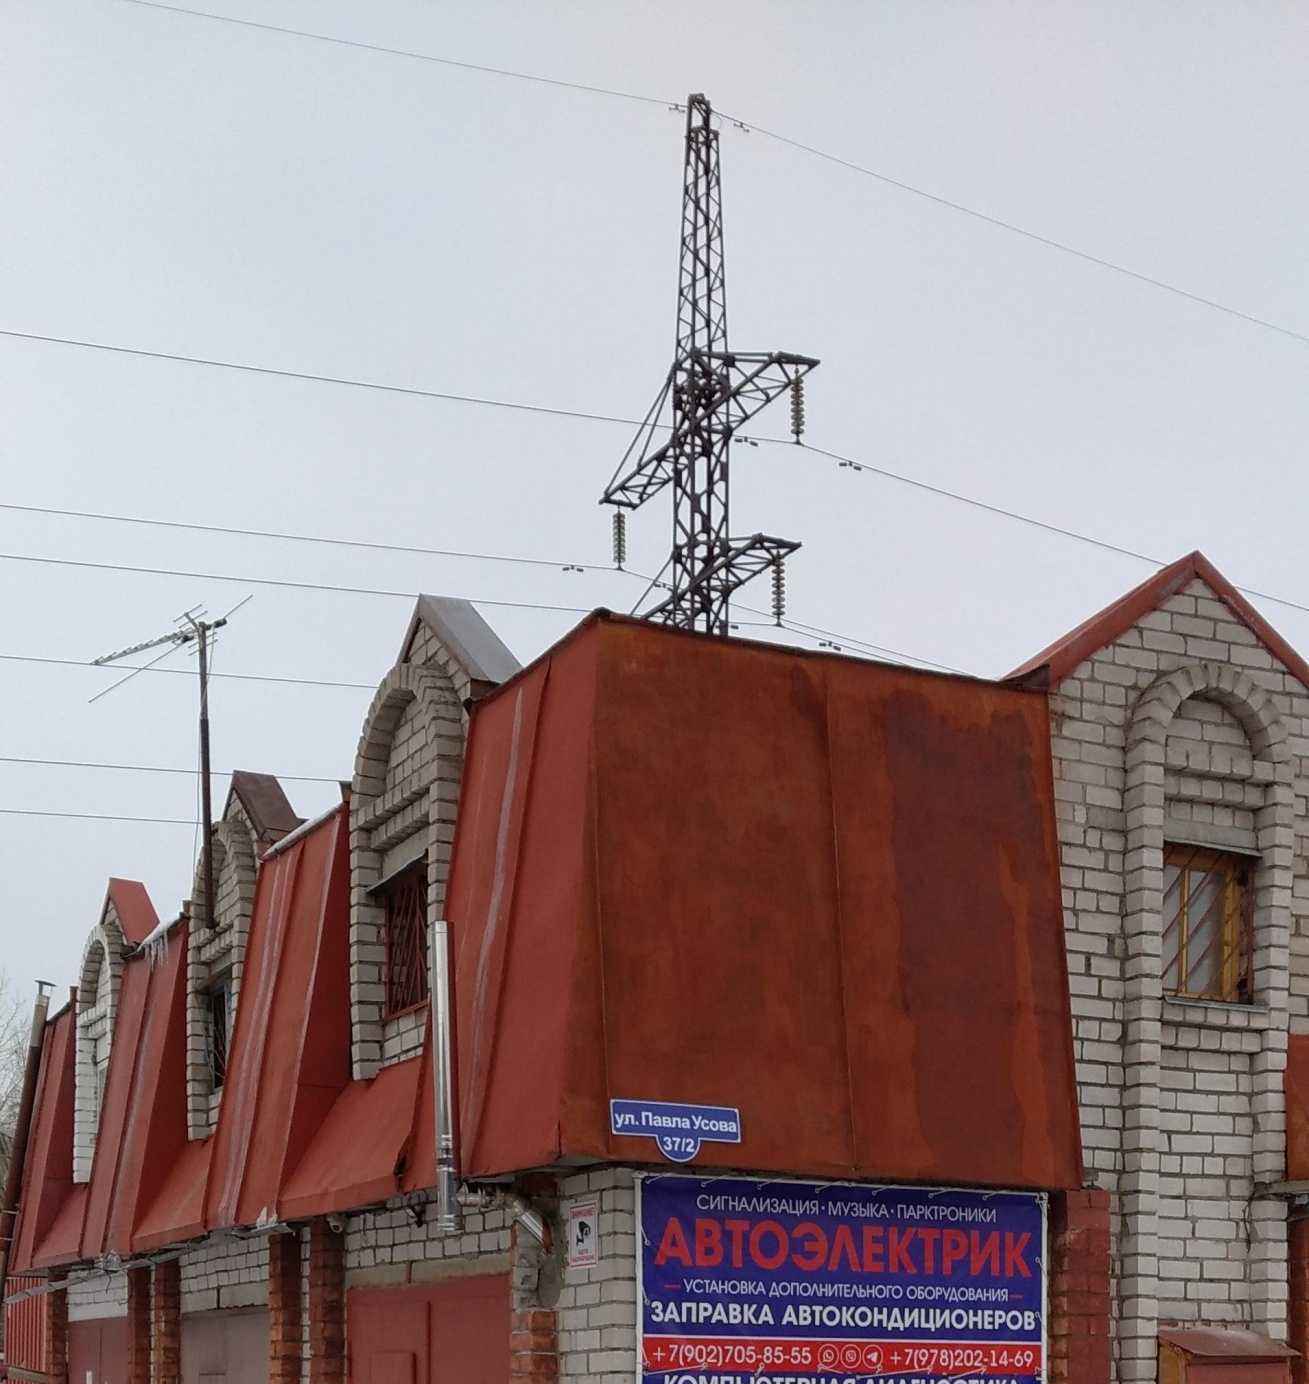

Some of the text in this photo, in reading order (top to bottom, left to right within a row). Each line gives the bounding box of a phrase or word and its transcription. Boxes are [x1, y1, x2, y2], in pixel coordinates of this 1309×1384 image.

[614, 1112, 737, 1133] ул. Павла Усова
[662, 1137, 695, 1153] 37/2
[696, 1194, 997, 1223] СИГНАЛИЗАЦИЯ МУЗЫКА ПАРКТРОНИКИ
[654, 1216, 1032, 1278] АВТОЭЛЕКТРИК
[682, 1278, 1009, 1303] УСТАНОВКА ДОПОЛНИТЕЛЬНОГО ОБОРУДОВАНИЯ
[650, 1301, 1036, 1332] ЗАПРАВКА АВТОКОНДИЦИОНЕРОВ
